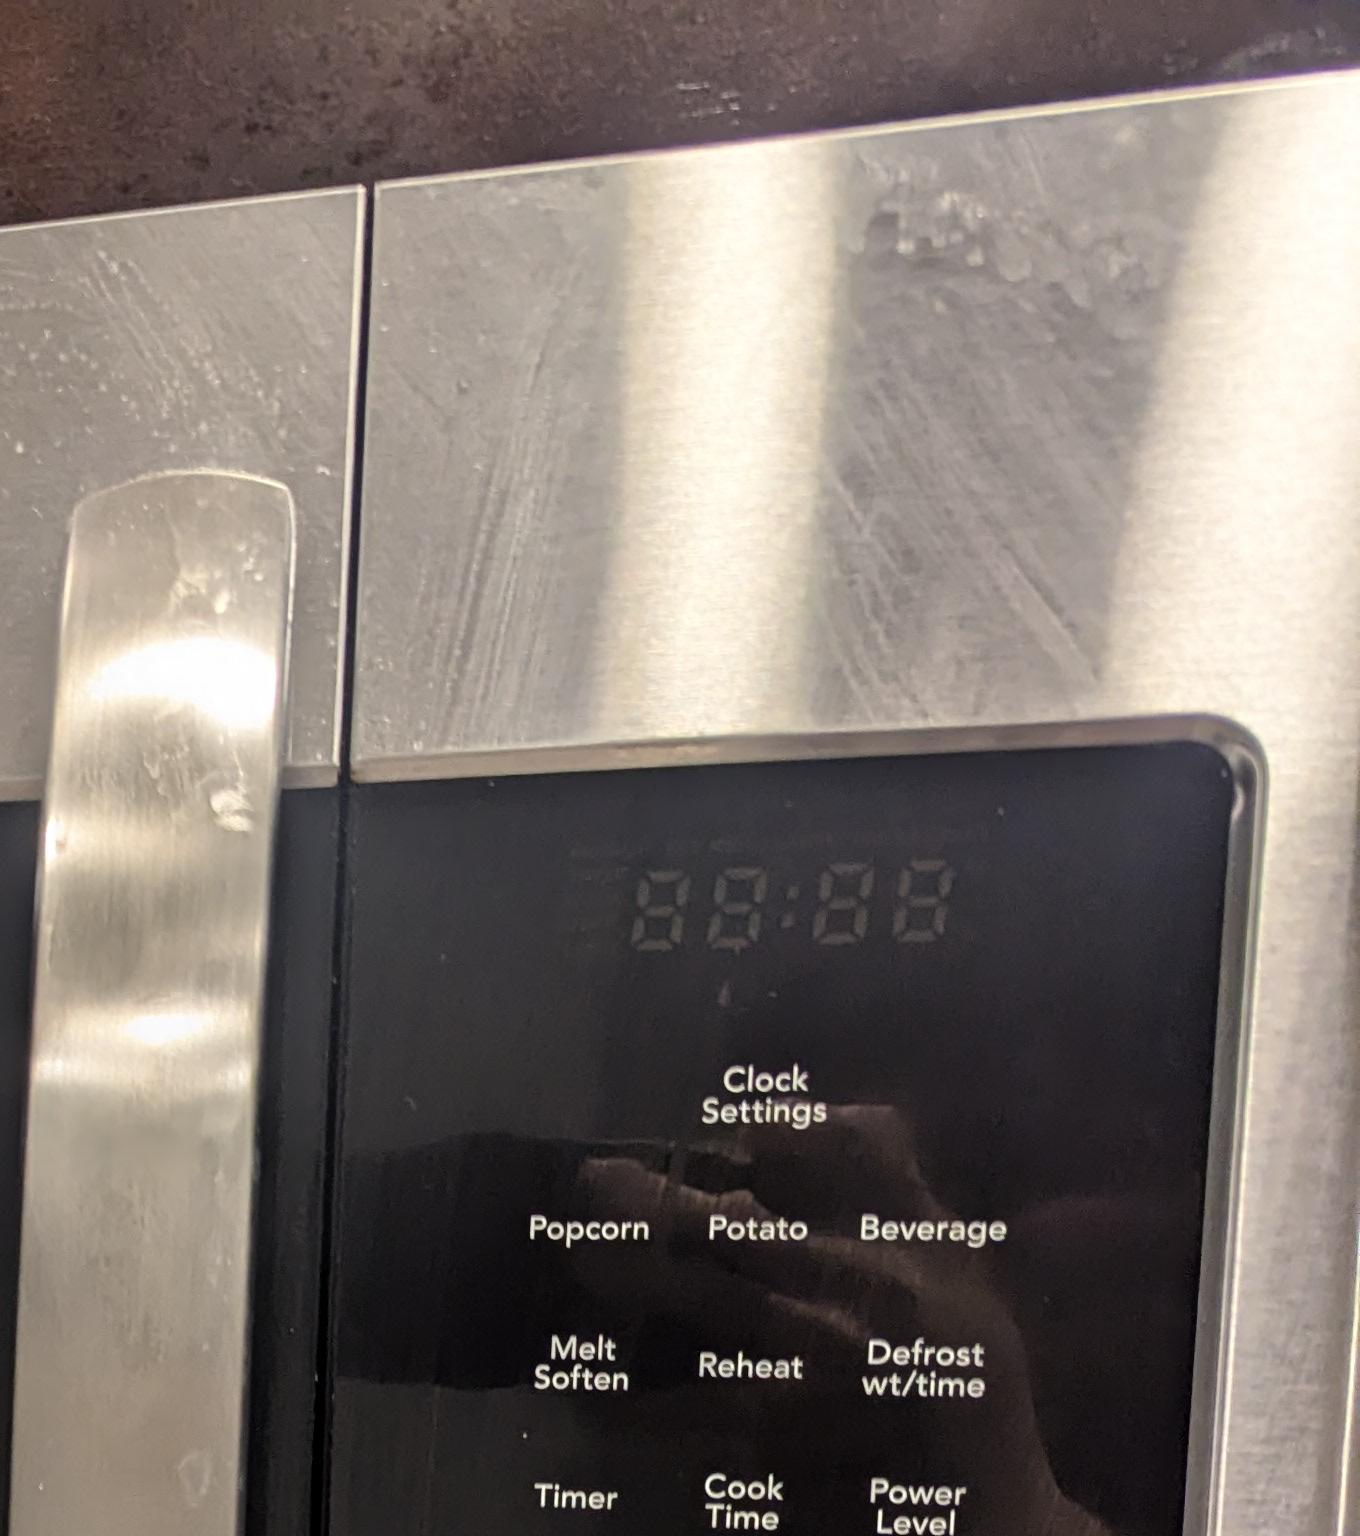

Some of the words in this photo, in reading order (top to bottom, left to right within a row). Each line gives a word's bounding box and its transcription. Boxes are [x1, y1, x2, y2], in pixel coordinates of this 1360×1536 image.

[723, 1063, 809, 1094] Clock
[701, 1097, 827, 1130] Settings
[529, 1214, 650, 1249] Popcorn
[708, 1214, 809, 1241] Potato
[860, 1213, 1007, 1249] Beverage
[550, 1334, 617, 1362] Melt
[867, 1337, 985, 1367] Defrost
[534, 1363, 629, 1391] Soften
[698, 1350, 804, 1380] Reheat
[861, 1370, 986, 1399] wt/time
[534, 1482, 618, 1510] Timer
[704, 1472, 784, 1501] Cook
[870, 1477, 967, 1506] Power
[704, 1503, 780, 1531] Time
[876, 1509, 956, 1536] Level
